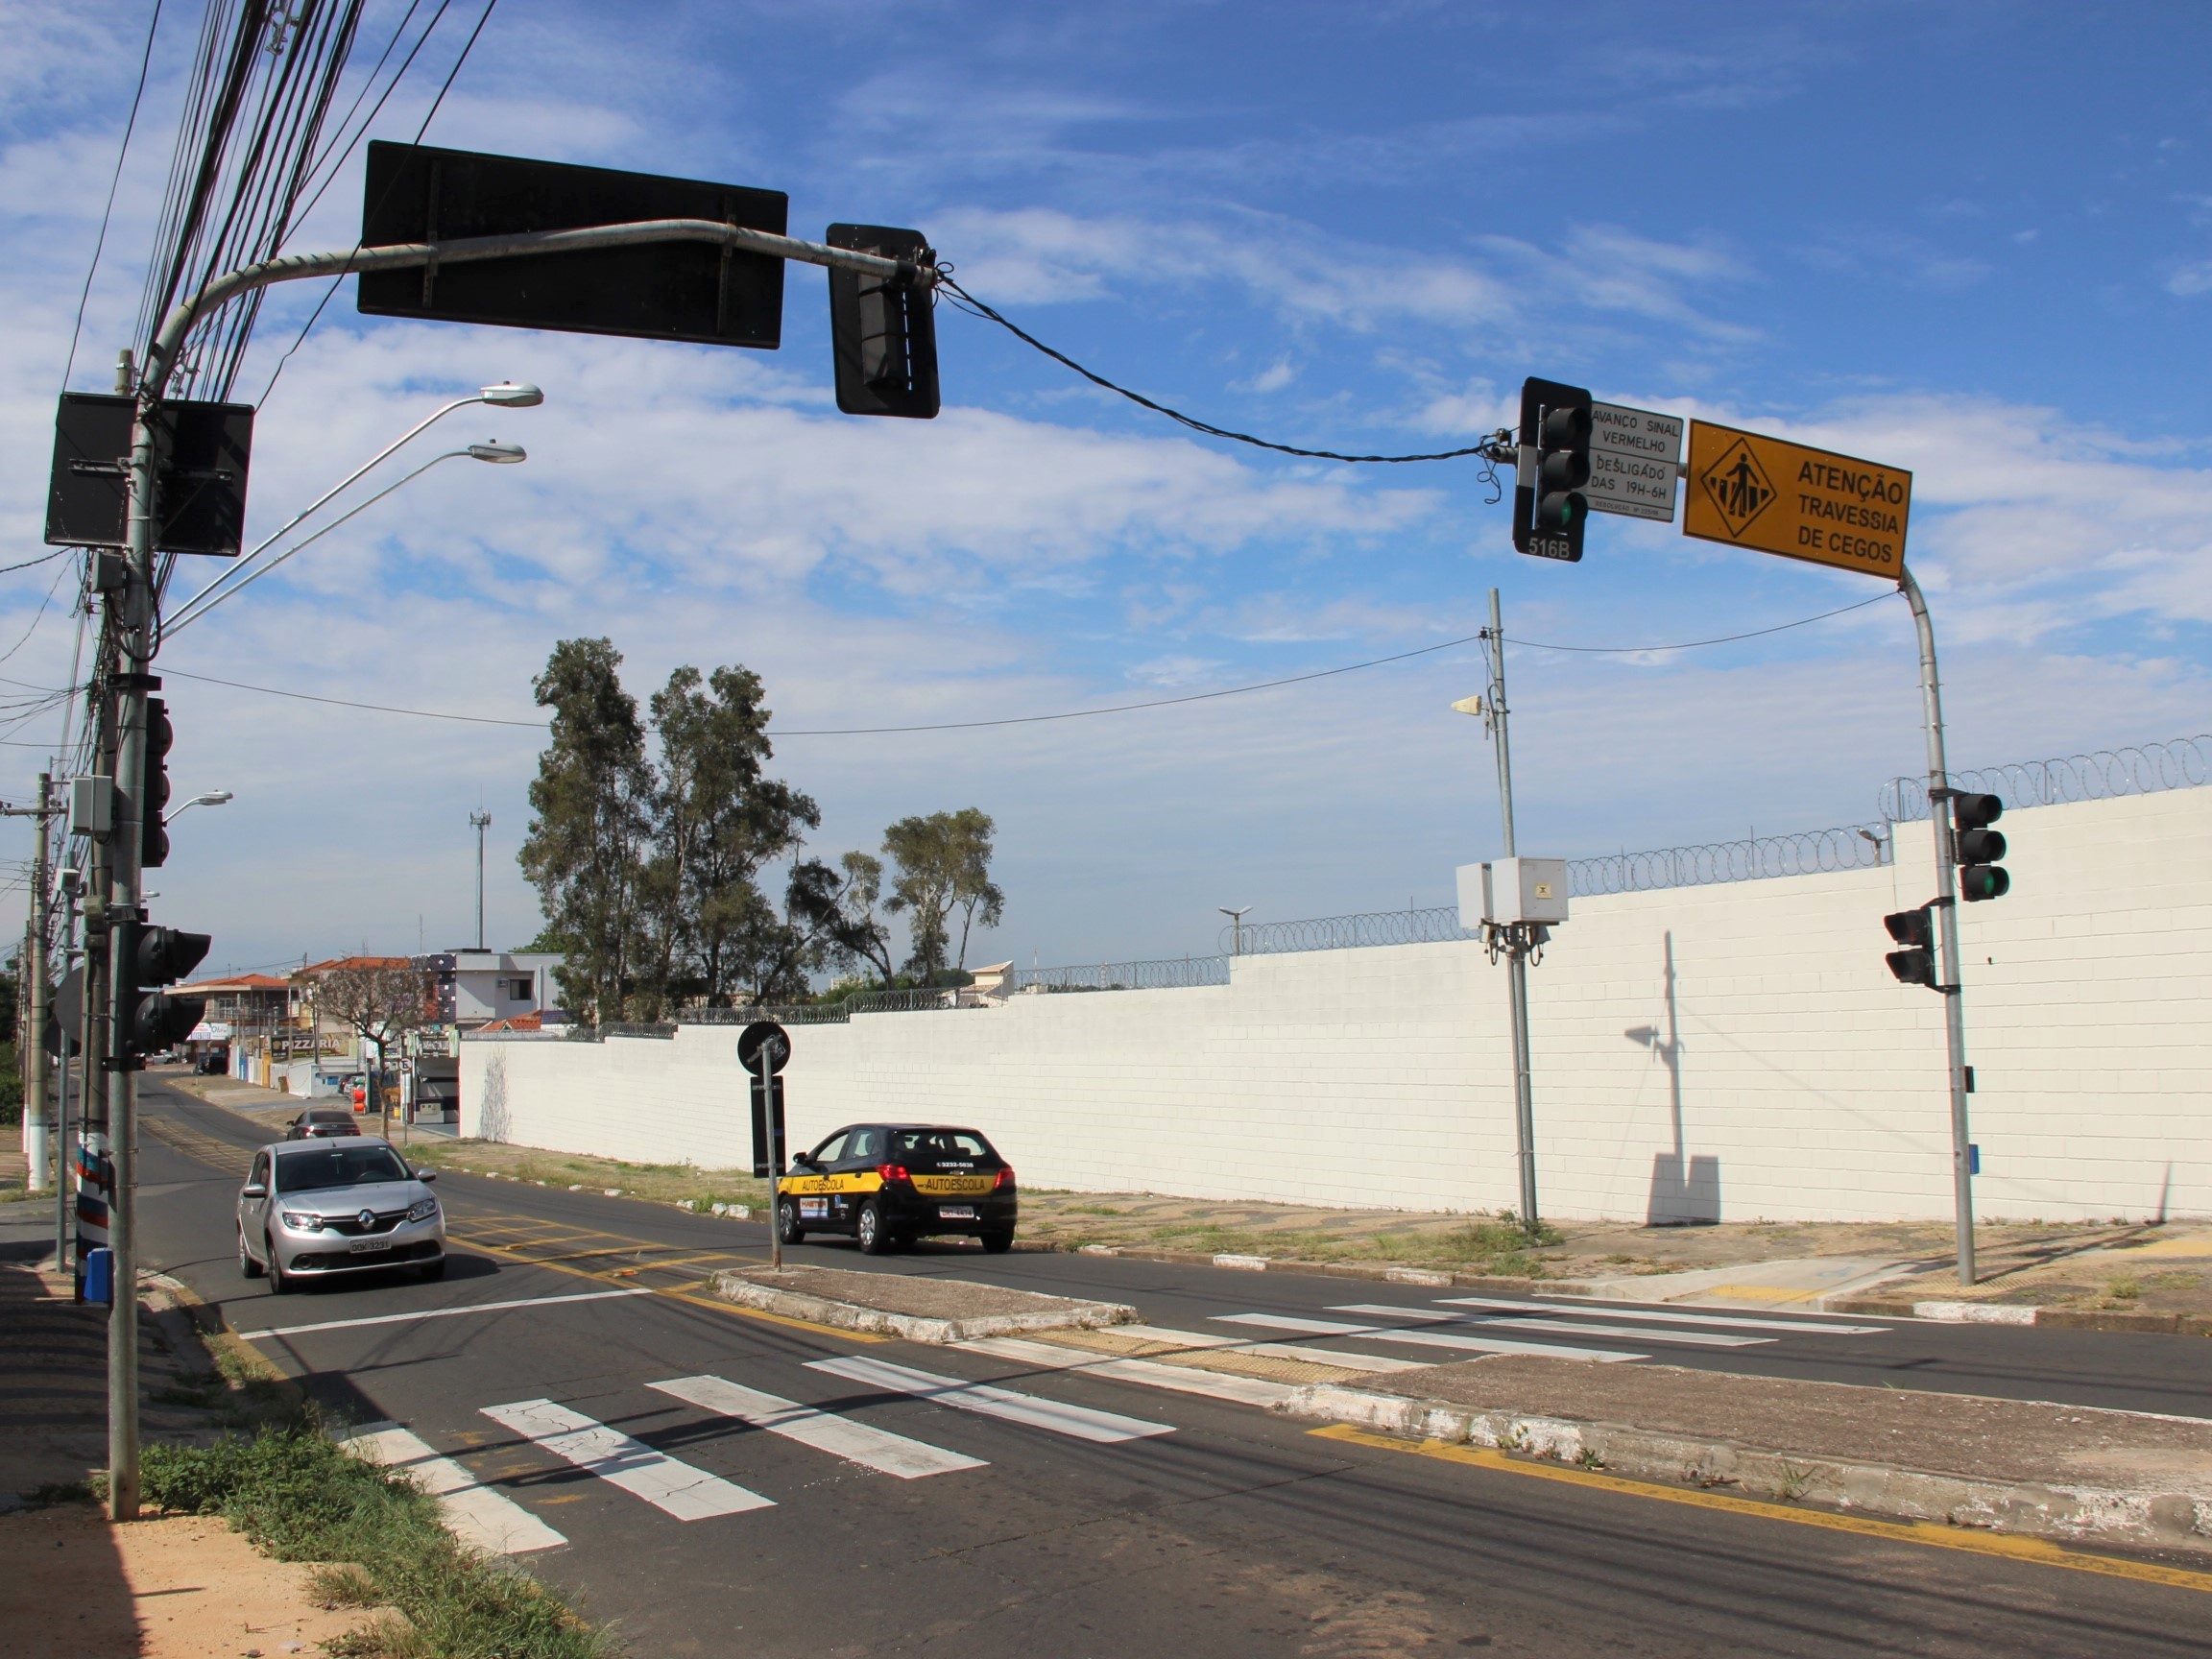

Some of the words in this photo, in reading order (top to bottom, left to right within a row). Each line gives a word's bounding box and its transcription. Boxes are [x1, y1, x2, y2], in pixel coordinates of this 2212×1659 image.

[1592, 410, 1638, 429] AVANÇO
[1647, 421, 1678, 438] SINAL
[1603, 430, 1666, 453] VERMELHO
[1597, 457, 1666, 480] DESLIGADO
[1591, 476, 1615, 491] DAS
[1626, 481, 1667, 499] 19H-6H
[1797, 461, 1904, 505] ATENÇÃO
[1798, 494, 1899, 534] TRAVESSIA
[1528, 538, 1571, 559] 516B
[1798, 525, 1823, 548] DE
[1828, 533, 1892, 563] CEGOS
[802, 1179, 845, 1191] AUTOESCOLA
[926, 1178, 986, 1191] AUTOESCOLA
